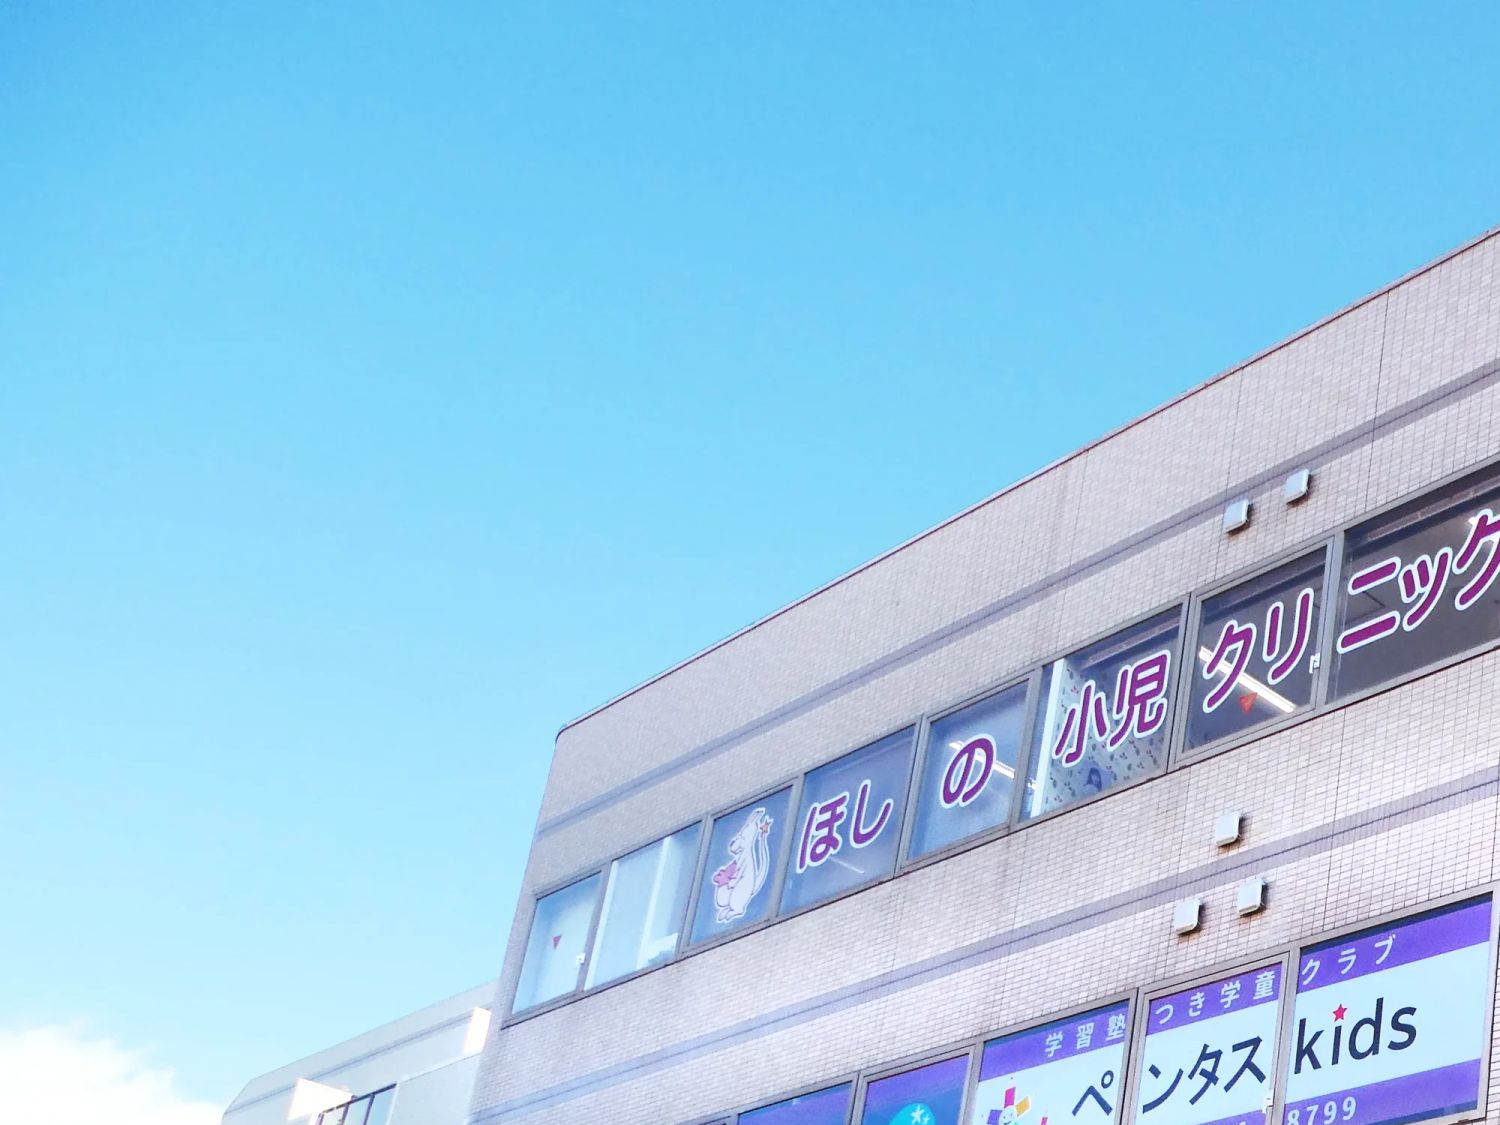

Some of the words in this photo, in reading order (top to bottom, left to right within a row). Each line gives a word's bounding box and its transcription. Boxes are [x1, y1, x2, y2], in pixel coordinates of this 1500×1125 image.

[1071, 1035, 1267, 1117] ペンタス
[1293, 996, 1418, 1075] kids
